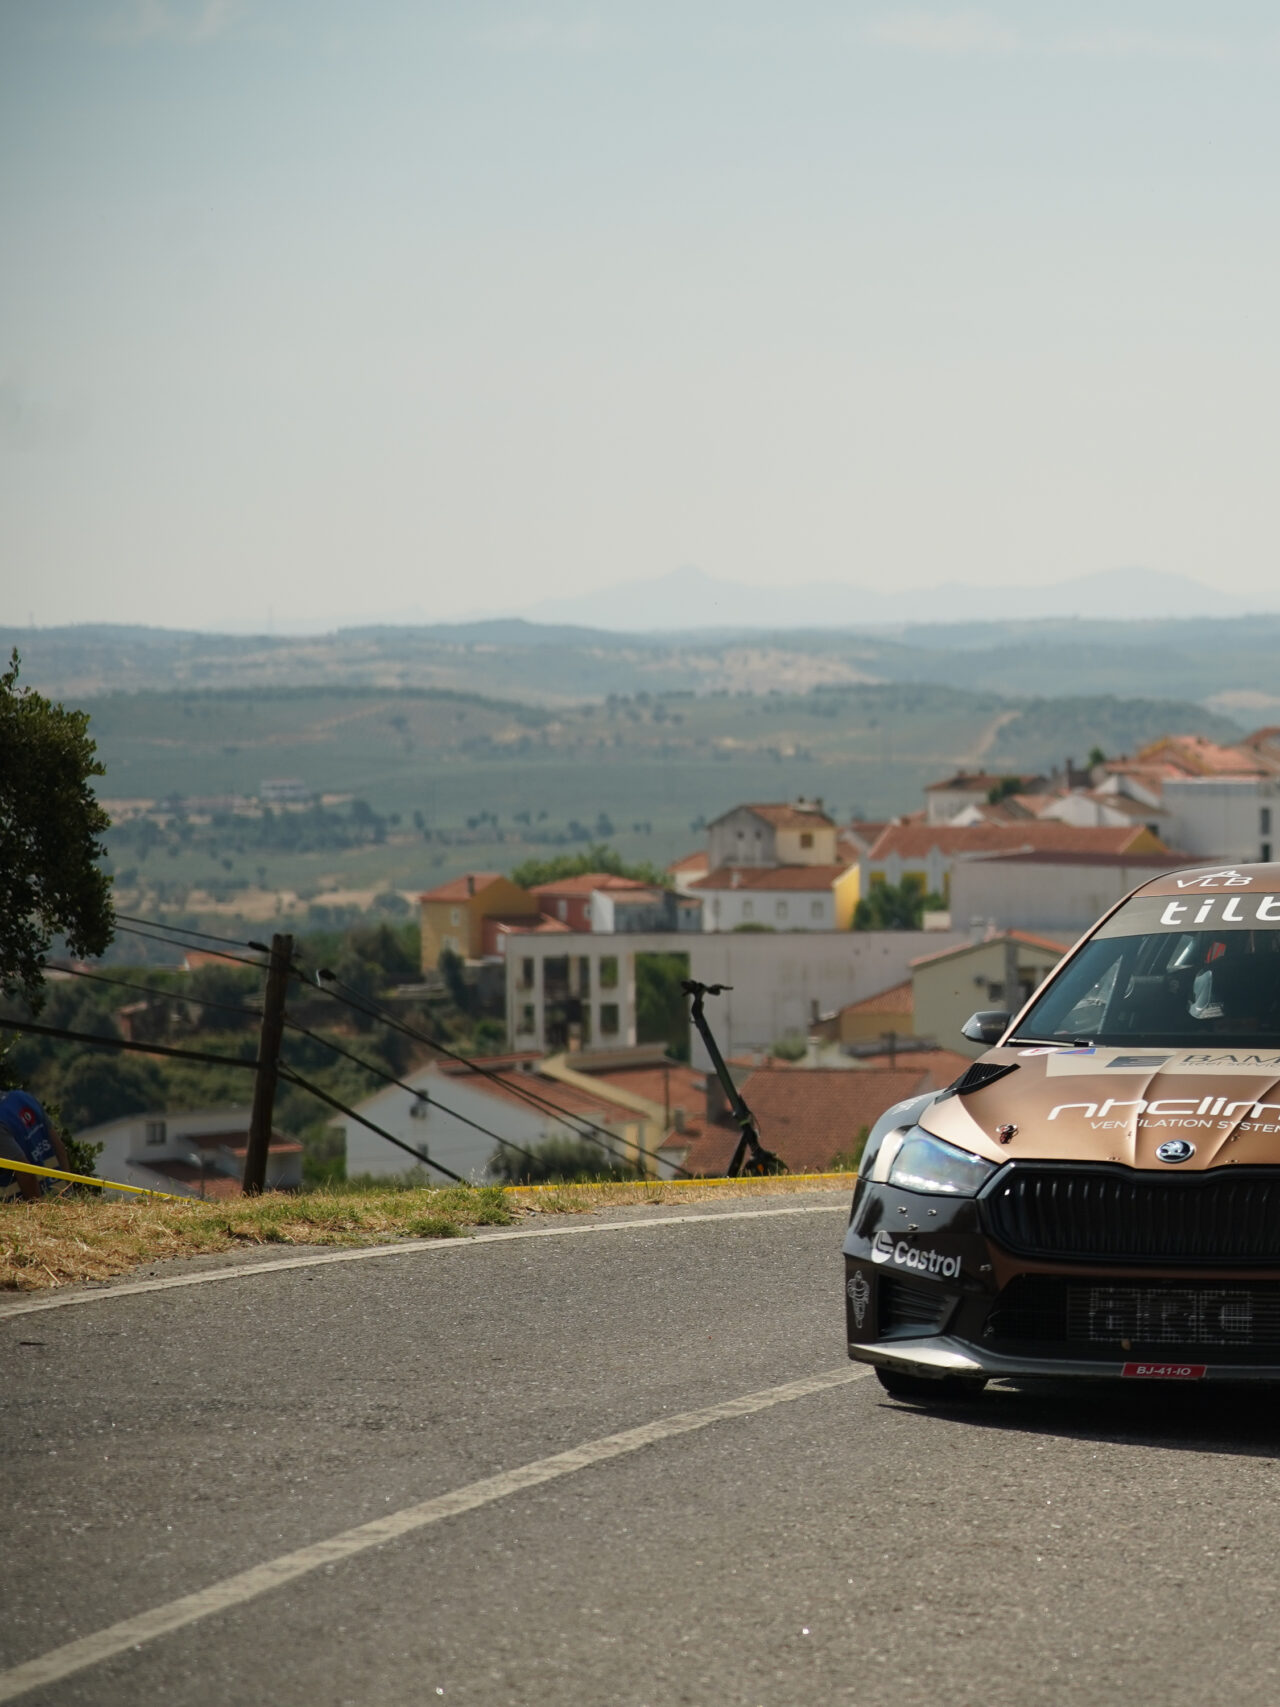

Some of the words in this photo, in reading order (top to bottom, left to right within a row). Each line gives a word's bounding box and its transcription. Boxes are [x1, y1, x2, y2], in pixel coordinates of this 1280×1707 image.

[1177, 876, 1254, 888] VLB
[893, 1241, 961, 1278] Castrol
[1136, 1366, 1192, 1376] BJ-41-IO
